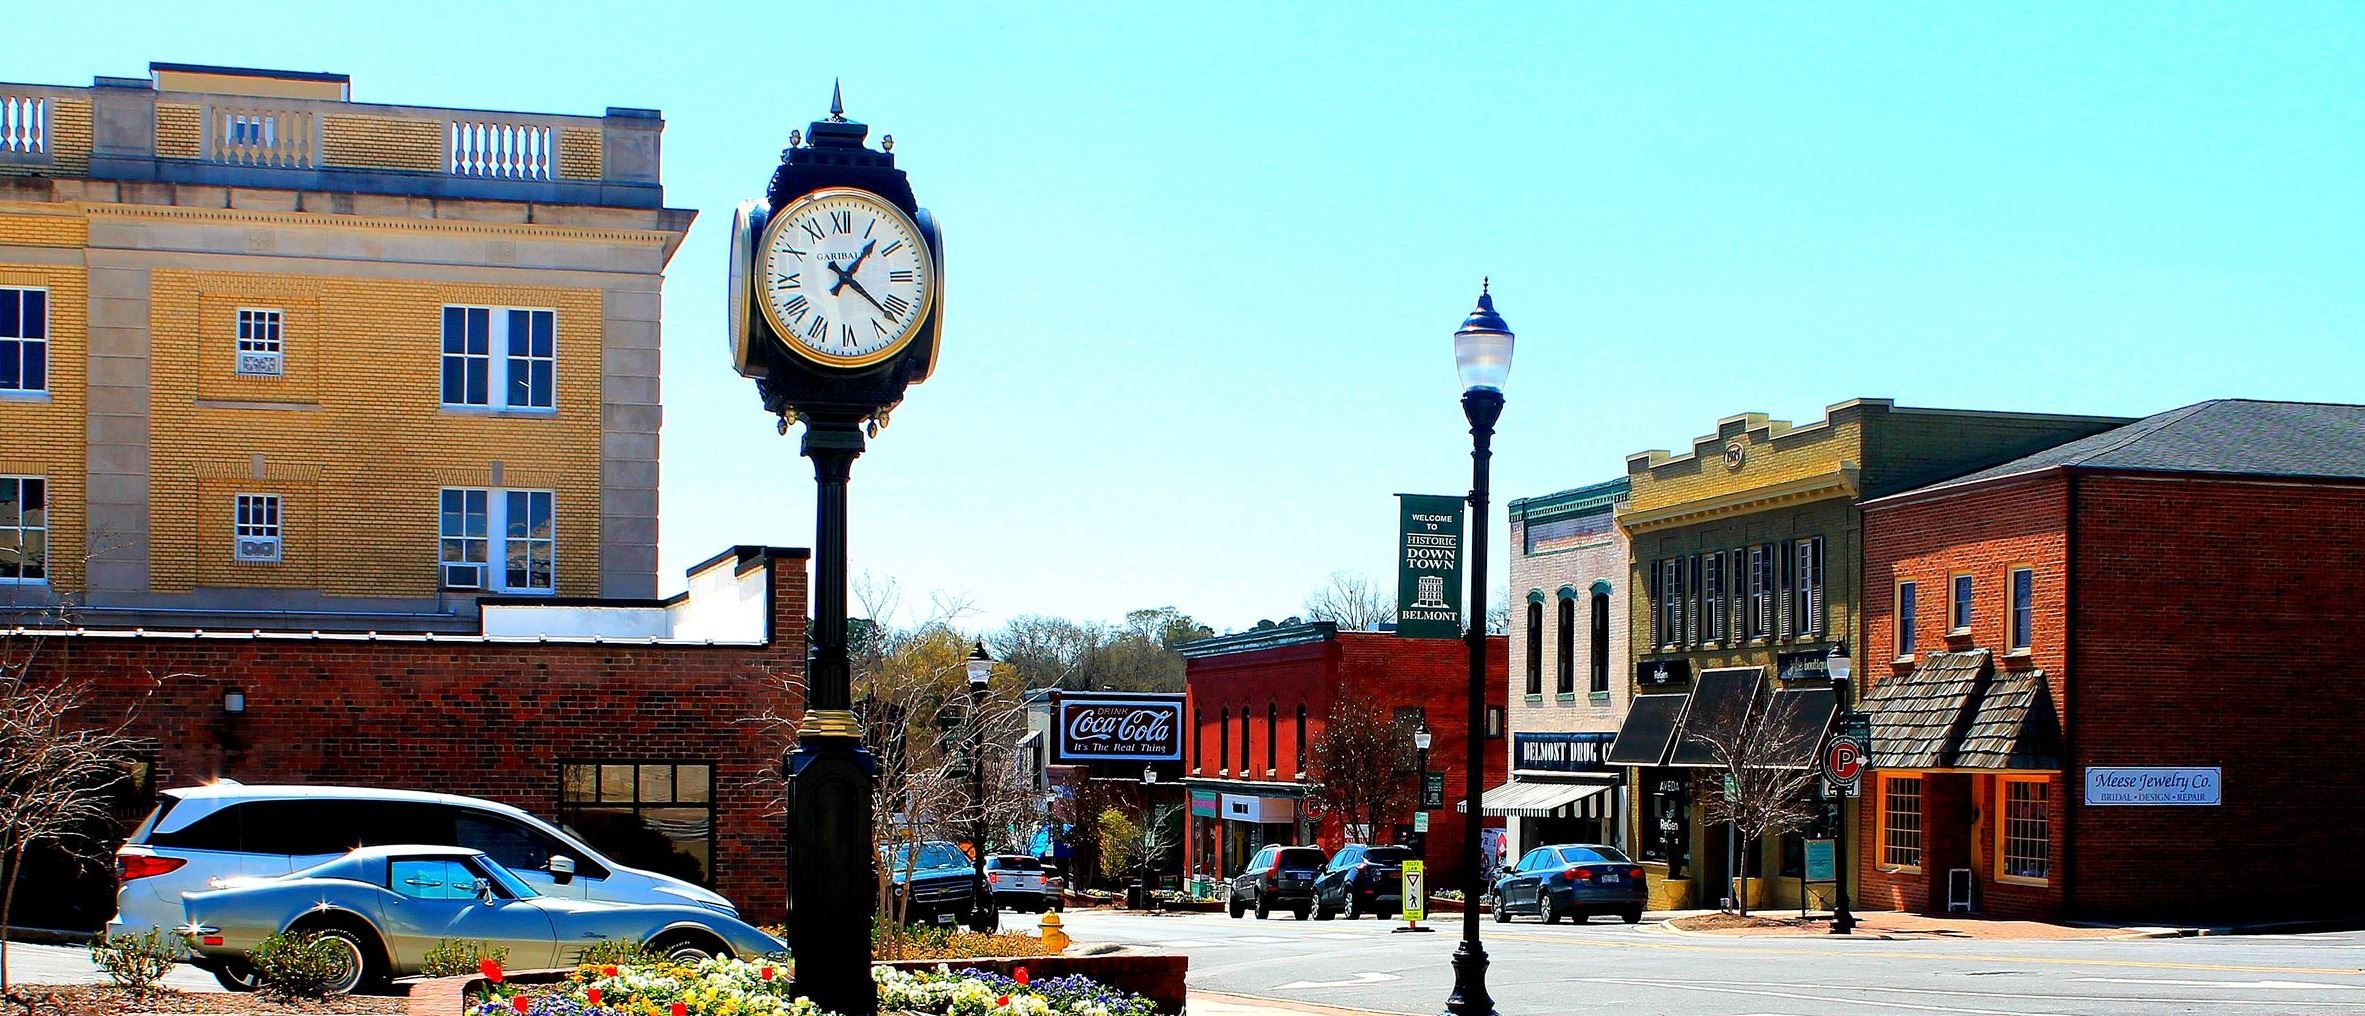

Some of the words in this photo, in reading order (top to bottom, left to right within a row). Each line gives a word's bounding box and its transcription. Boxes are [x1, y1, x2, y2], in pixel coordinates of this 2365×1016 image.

[830, 211, 851, 234] XII
[864, 218, 876, 239] I
[801, 217, 825, 244] XI
[782, 243, 806, 262] X
[881, 240, 903, 257] II
[777, 272, 801, 290] IX
[889, 270, 913, 283] III
[1412, 513, 1453, 523] WELCOME
[1426, 523, 1438, 531] TO
[1407, 535, 1457, 546] HISTORIC
[1406, 548, 1456, 560] DOWN
[1406, 558, 1454, 570] TOWN
[1402, 610, 1458, 621] BELMONT
[1097, 707, 1129, 715] DRINK
[1069, 709, 1174, 742] Coca-Cola
[1073, 742, 1089, 751] It's
[1092, 742, 1108, 752] The
[1113, 743, 1135, 752] Real
[1140, 743, 1166, 753] Thing
[1523, 742, 1567, 762] BELMONT
[1570, 742, 1597, 762] DRUG
[1837, 748, 1856, 772] P
[1659, 780, 1680, 792] AVEDA
[2095, 771, 2136, 788] Meese
[2138, 771, 2189, 792] Jewelry
[2191, 774, 2211, 789] Co.
[2101, 793, 2132, 802] BRIDAL
[2138, 793, 2171, 802] DESIGN
[2177, 793, 2206, 802] REPAIR
[1660, 818, 1679, 831] ReGen
